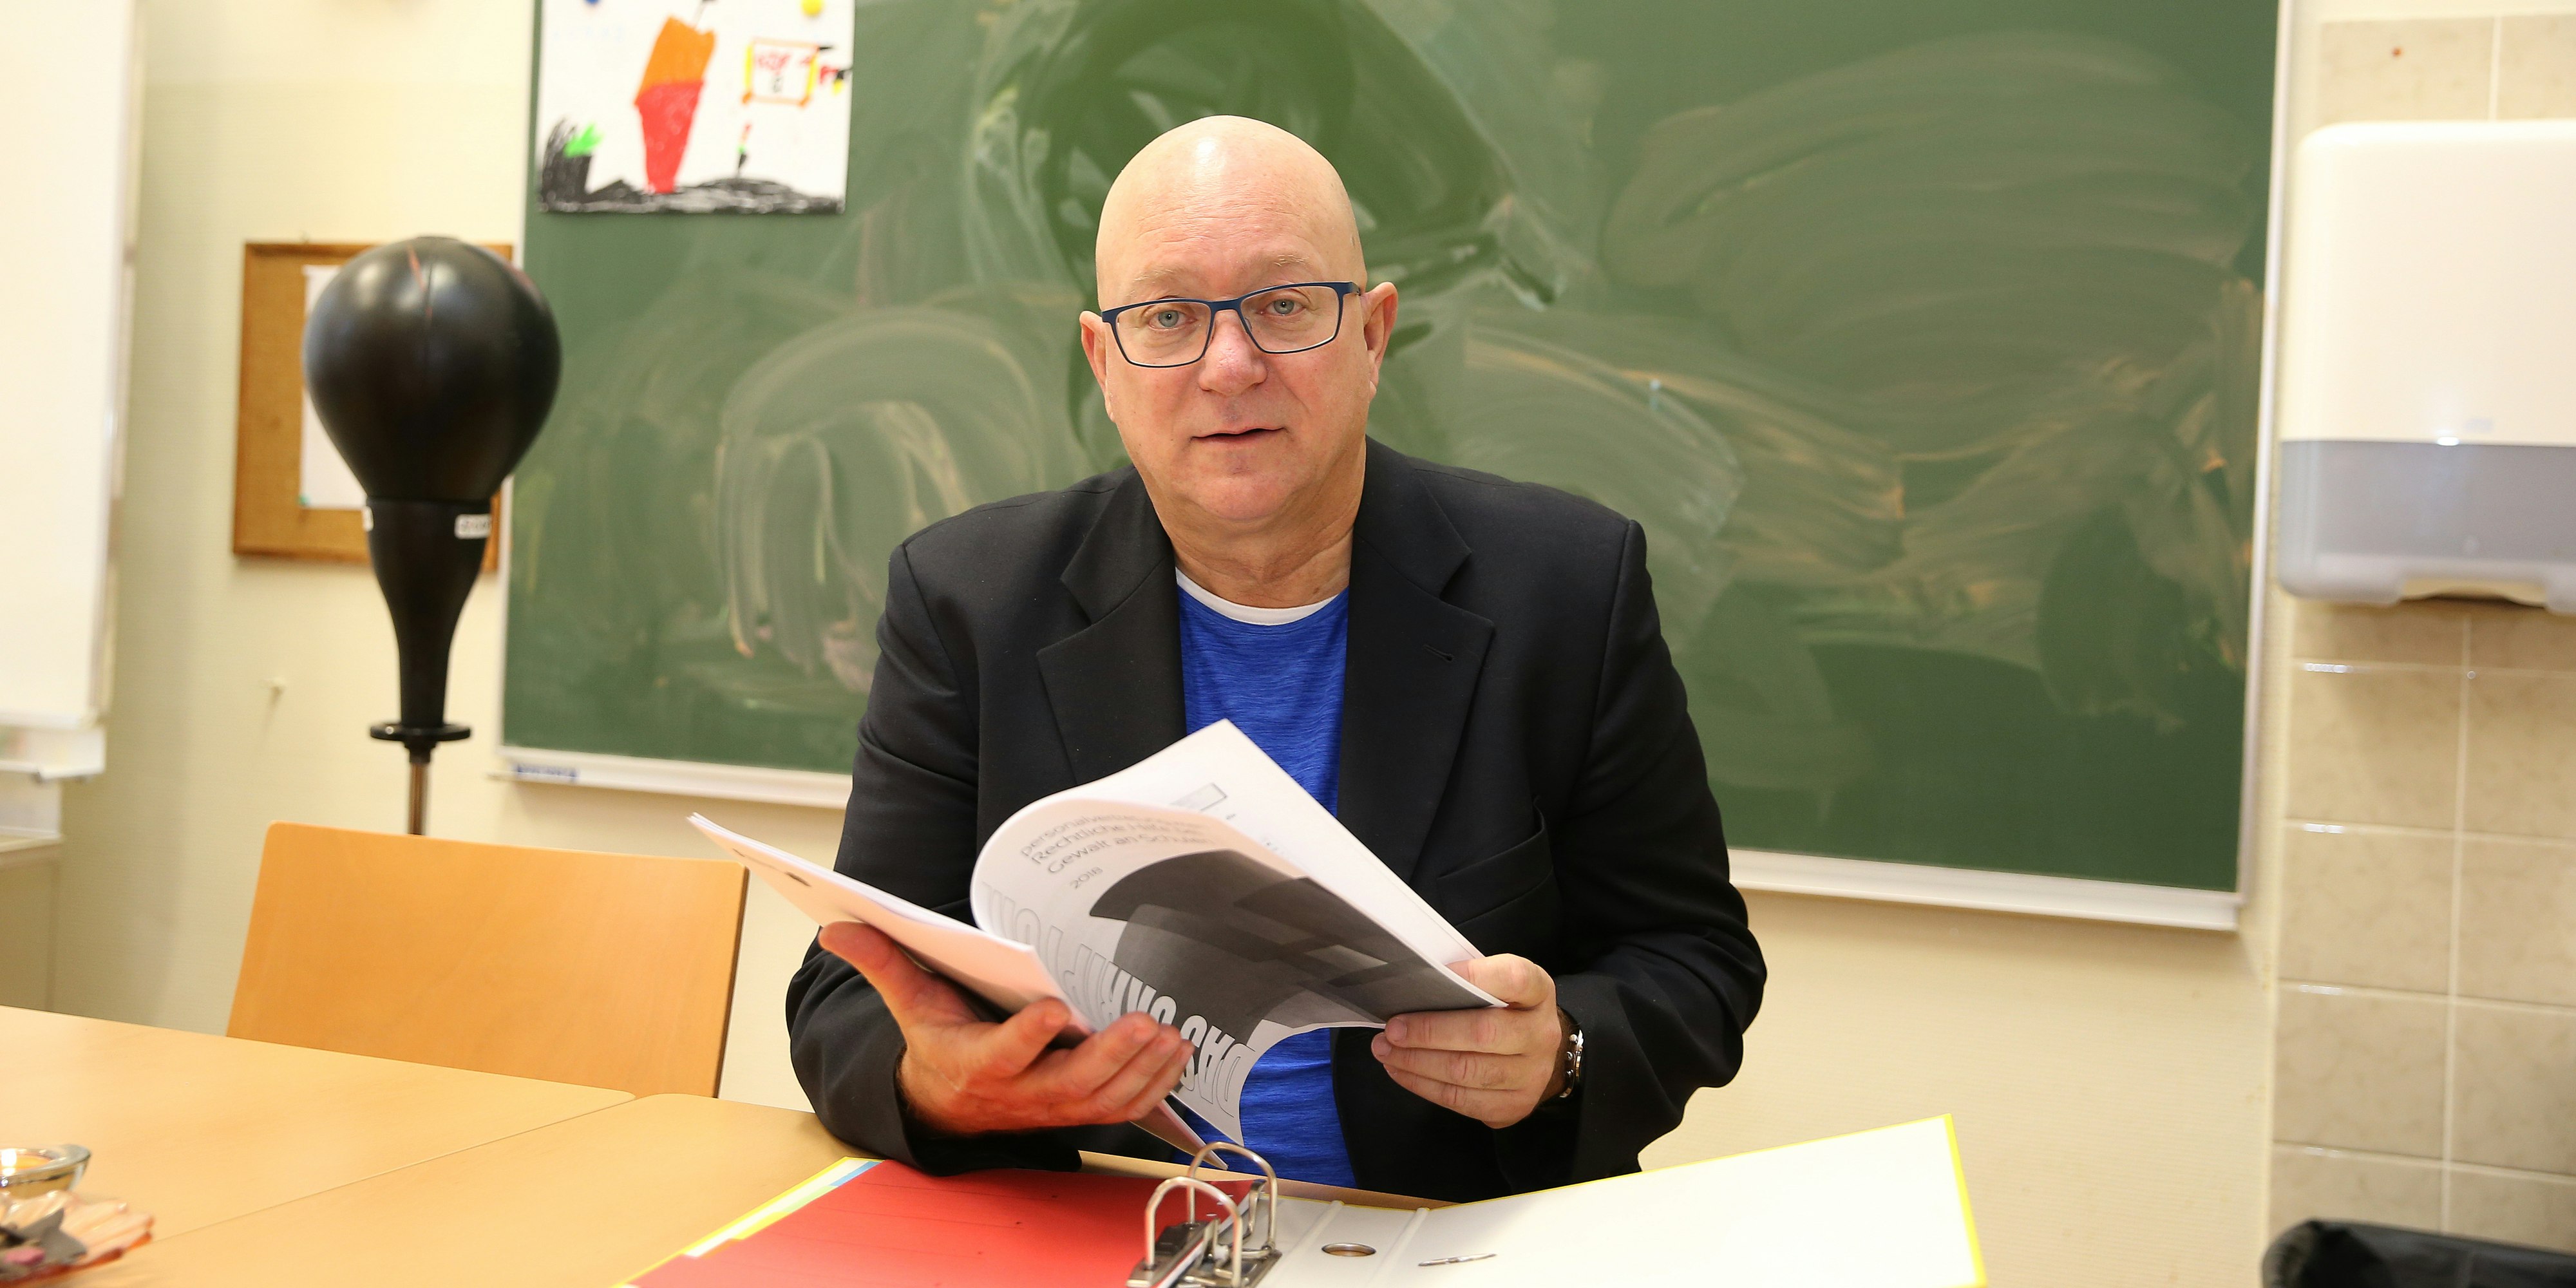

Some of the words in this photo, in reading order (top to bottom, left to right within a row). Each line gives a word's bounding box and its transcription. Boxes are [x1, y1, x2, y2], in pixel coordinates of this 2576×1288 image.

[1032, 823, 1124, 864] Rechtliche
[1048, 839, 1112, 873] Gewalt
[1114, 836, 1139, 845] an
[1069, 866, 1103, 889] 2018
[1180, 1014, 1256, 1118] DAS
